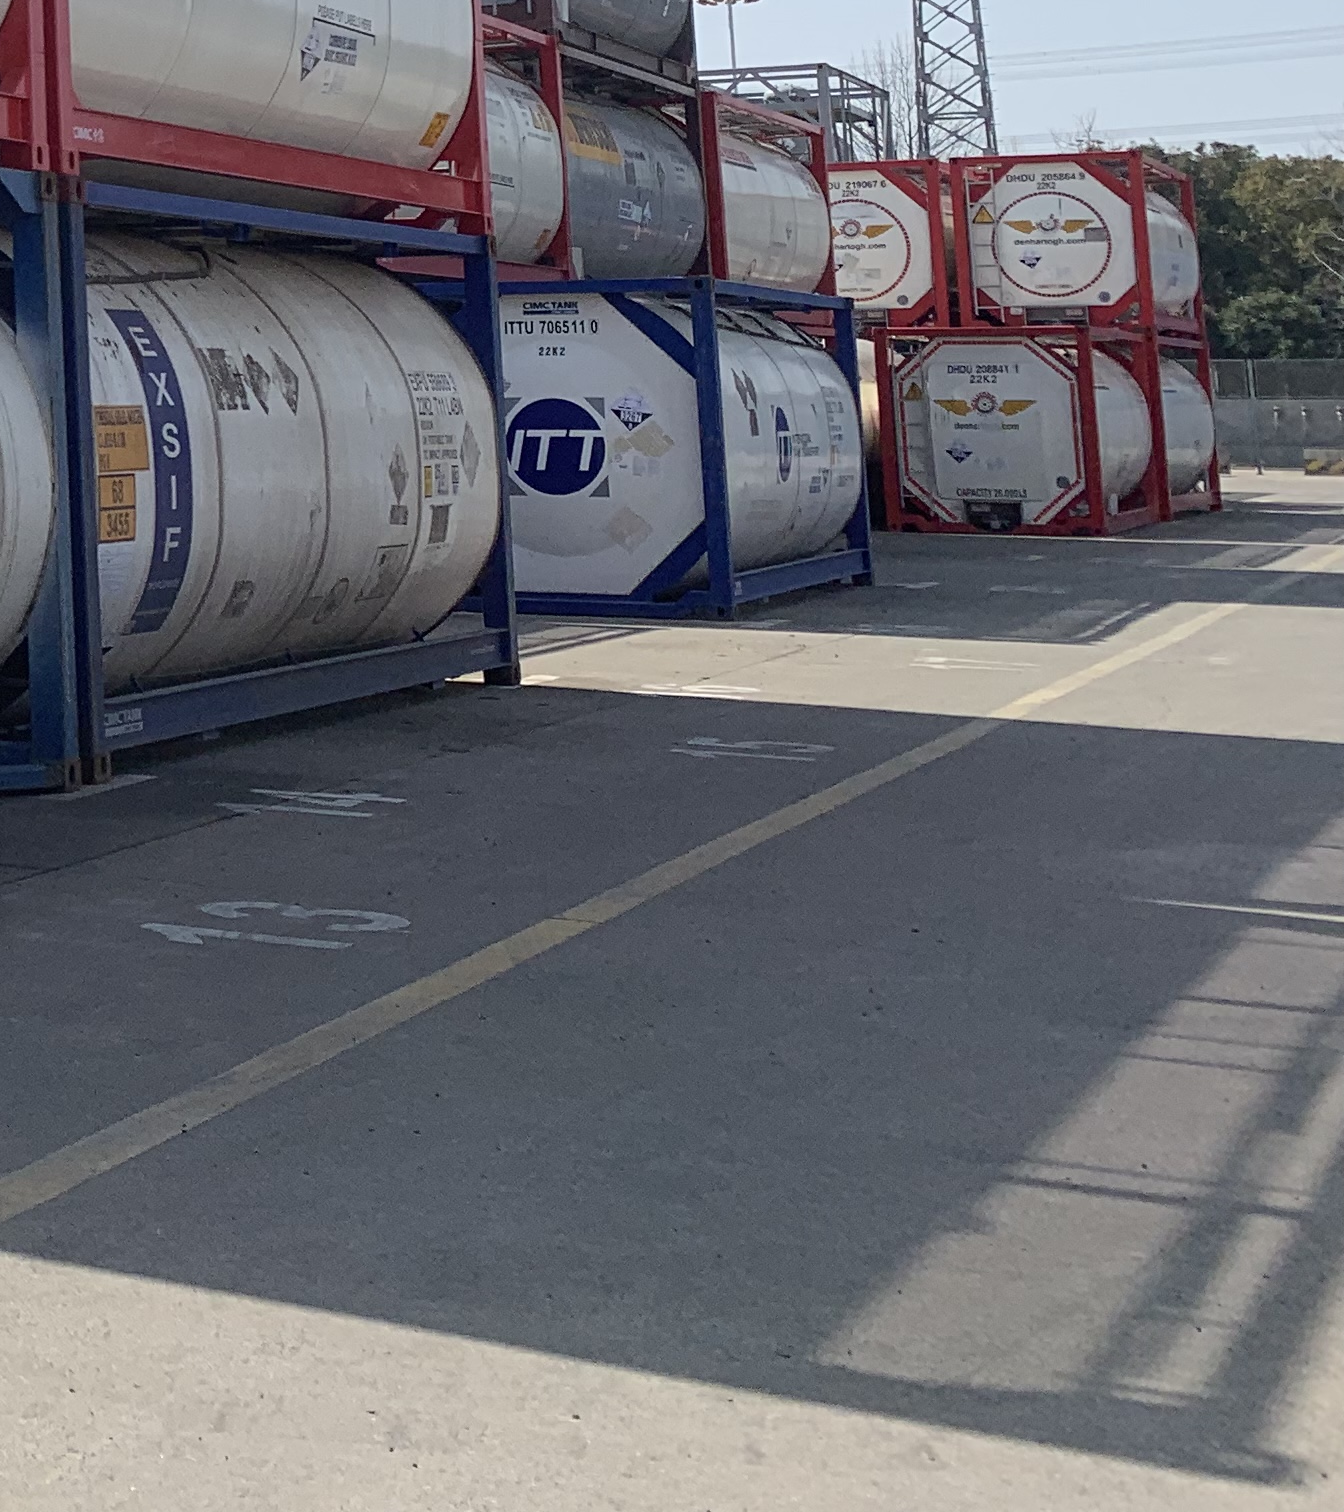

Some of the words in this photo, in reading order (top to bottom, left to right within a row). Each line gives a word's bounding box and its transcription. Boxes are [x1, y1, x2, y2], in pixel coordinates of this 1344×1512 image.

[504, 321, 533, 335] ITTU
[539, 320, 585, 334] 706511
[538, 347, 565, 356] 22K2
[970, 375, 997, 383] 22K2
[512, 428, 605, 472] ITT
